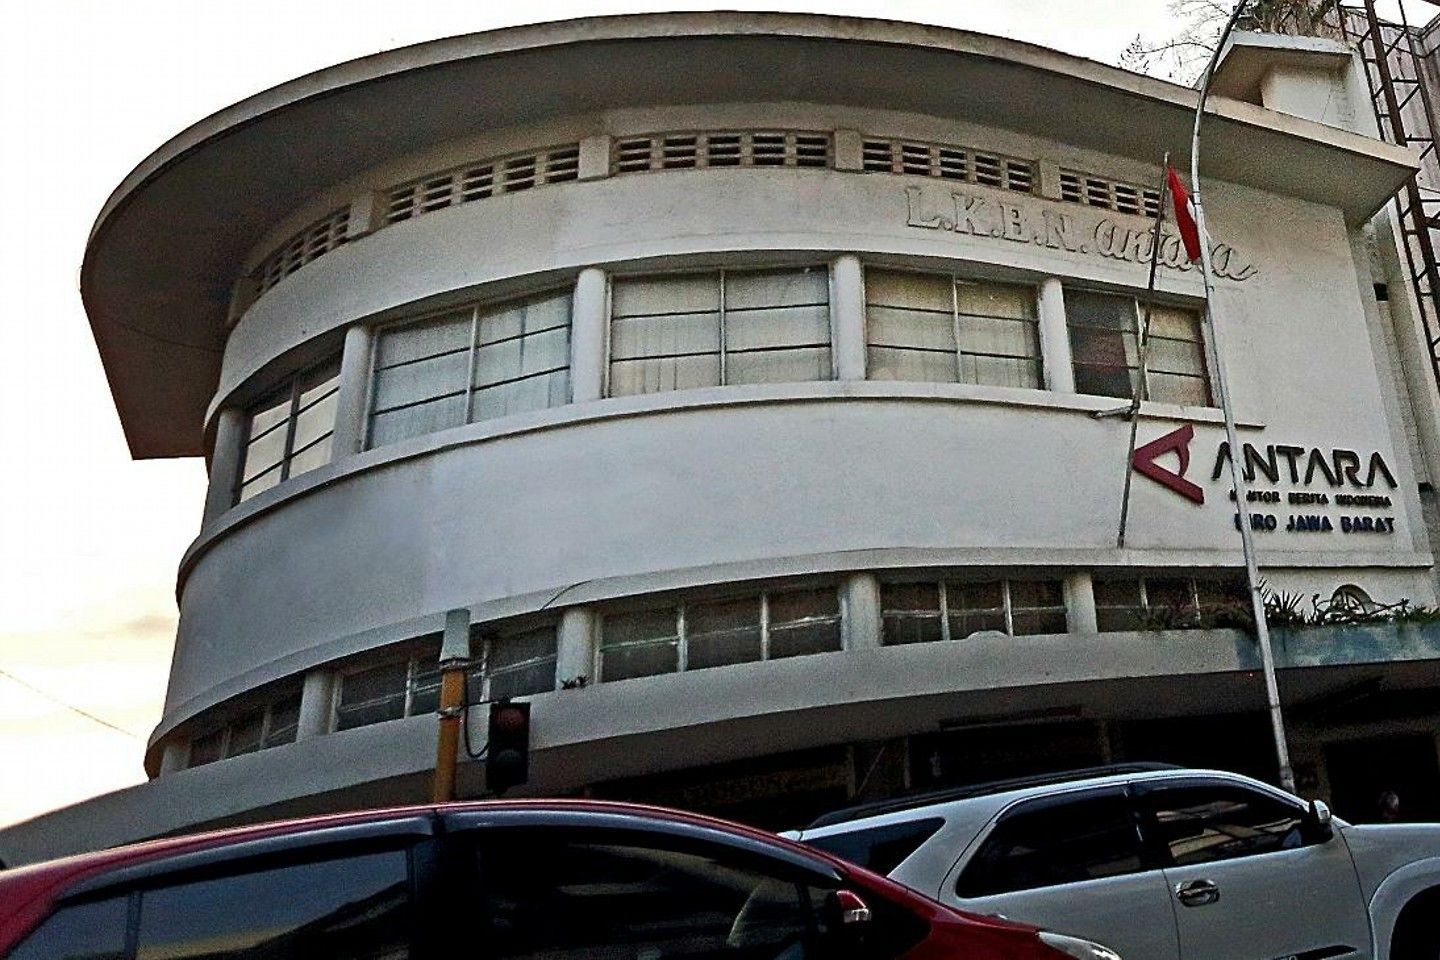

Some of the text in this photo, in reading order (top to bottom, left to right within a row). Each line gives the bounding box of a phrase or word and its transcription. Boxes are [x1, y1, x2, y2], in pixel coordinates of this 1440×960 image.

[1211, 441, 1398, 489] ANTARA
[1286, 514, 1333, 533] JAWA
[1340, 516, 1395, 533] BARAT
